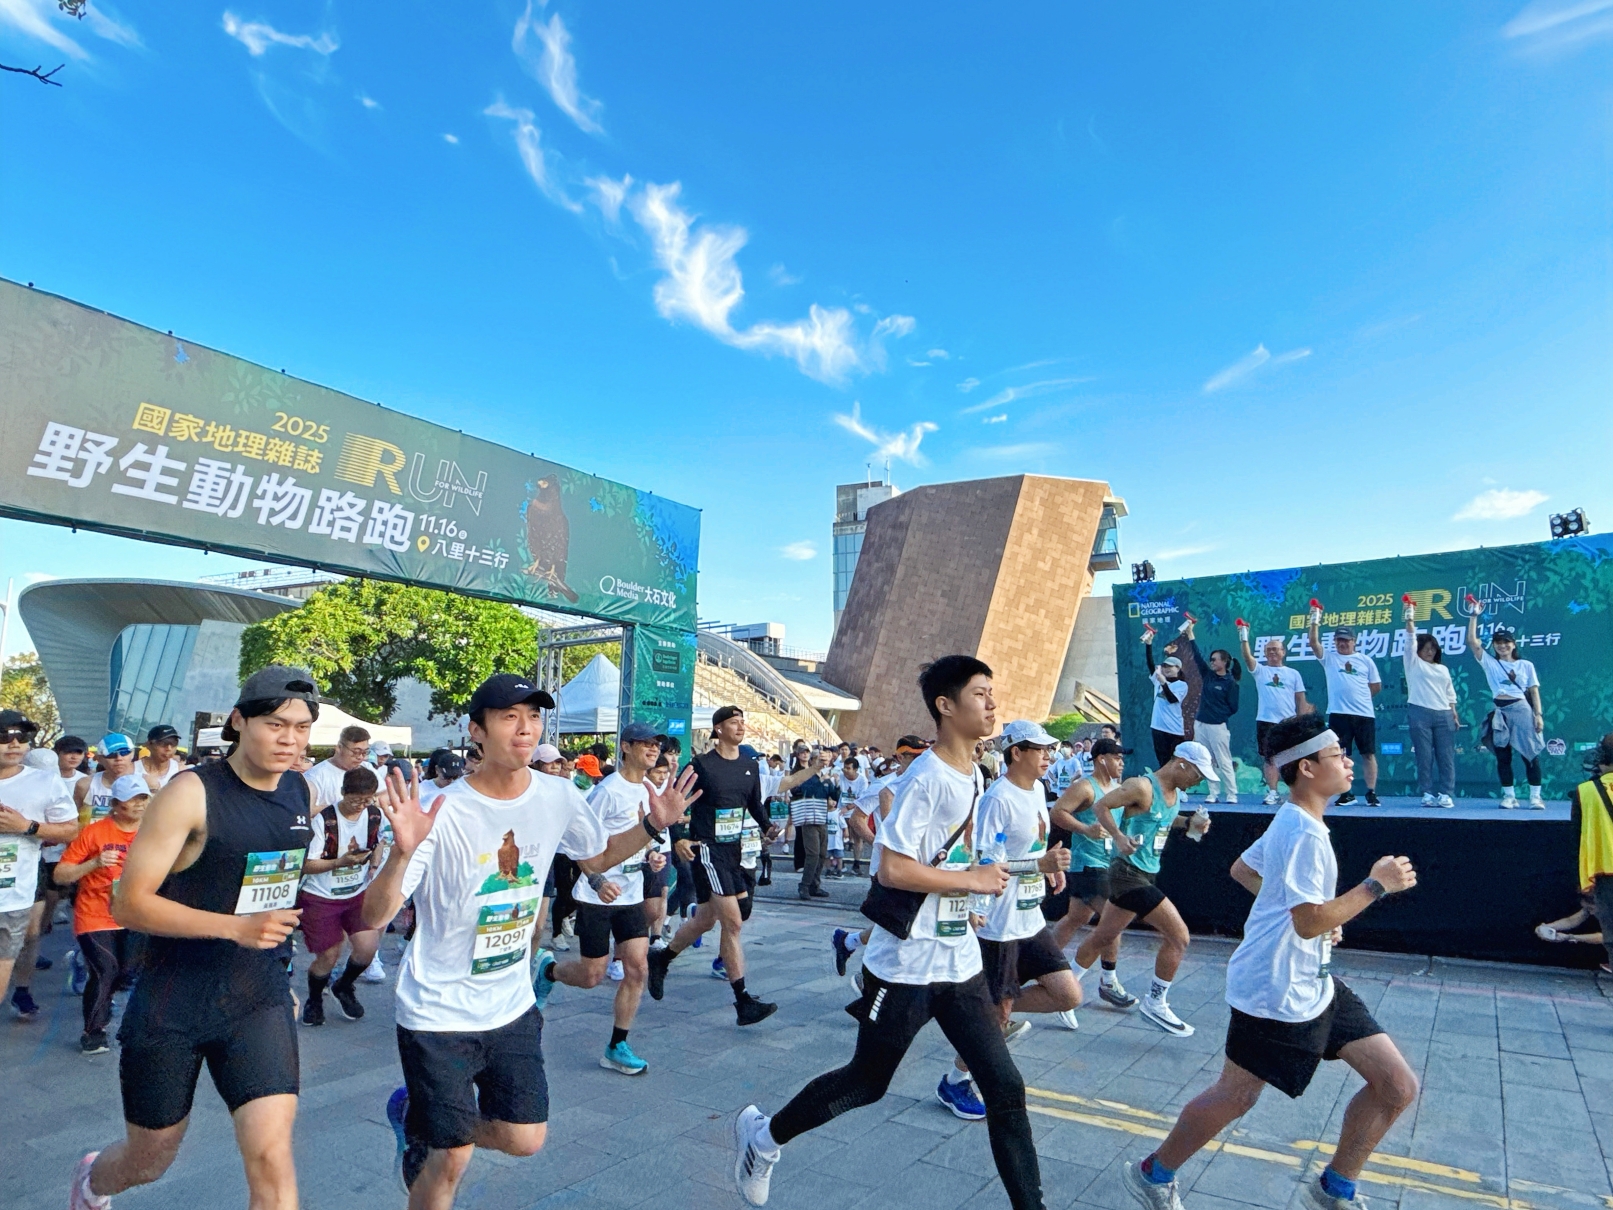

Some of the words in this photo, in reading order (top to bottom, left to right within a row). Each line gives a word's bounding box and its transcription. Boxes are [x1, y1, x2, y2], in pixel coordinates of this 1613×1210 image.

[271, 412, 331, 444] 2025
[132, 402, 325, 475] 國家地理雜誌
[334, 432, 488, 516] RUN
[26, 421, 415, 552] 野生動物路跑
[434, 480, 450, 490] FOR
[451, 484, 484, 499] WILDLIFE
[419, 514, 458, 538] 11.16
[431, 539, 510, 569] 八里十三行
[616, 578, 645, 593] Boulder
[616, 587, 639, 600] Media
[644, 586, 676, 608] 大石文化
[1141, 601, 1171, 609] NATIONAL
[1357, 593, 1394, 608] 2025
[1493, 595, 1524, 604] WILDLIFE
[1141, 606, 1179, 616] GEOGRAPHIC
[251, 884, 290, 902] 11108
[485, 928, 526, 949] 12091
